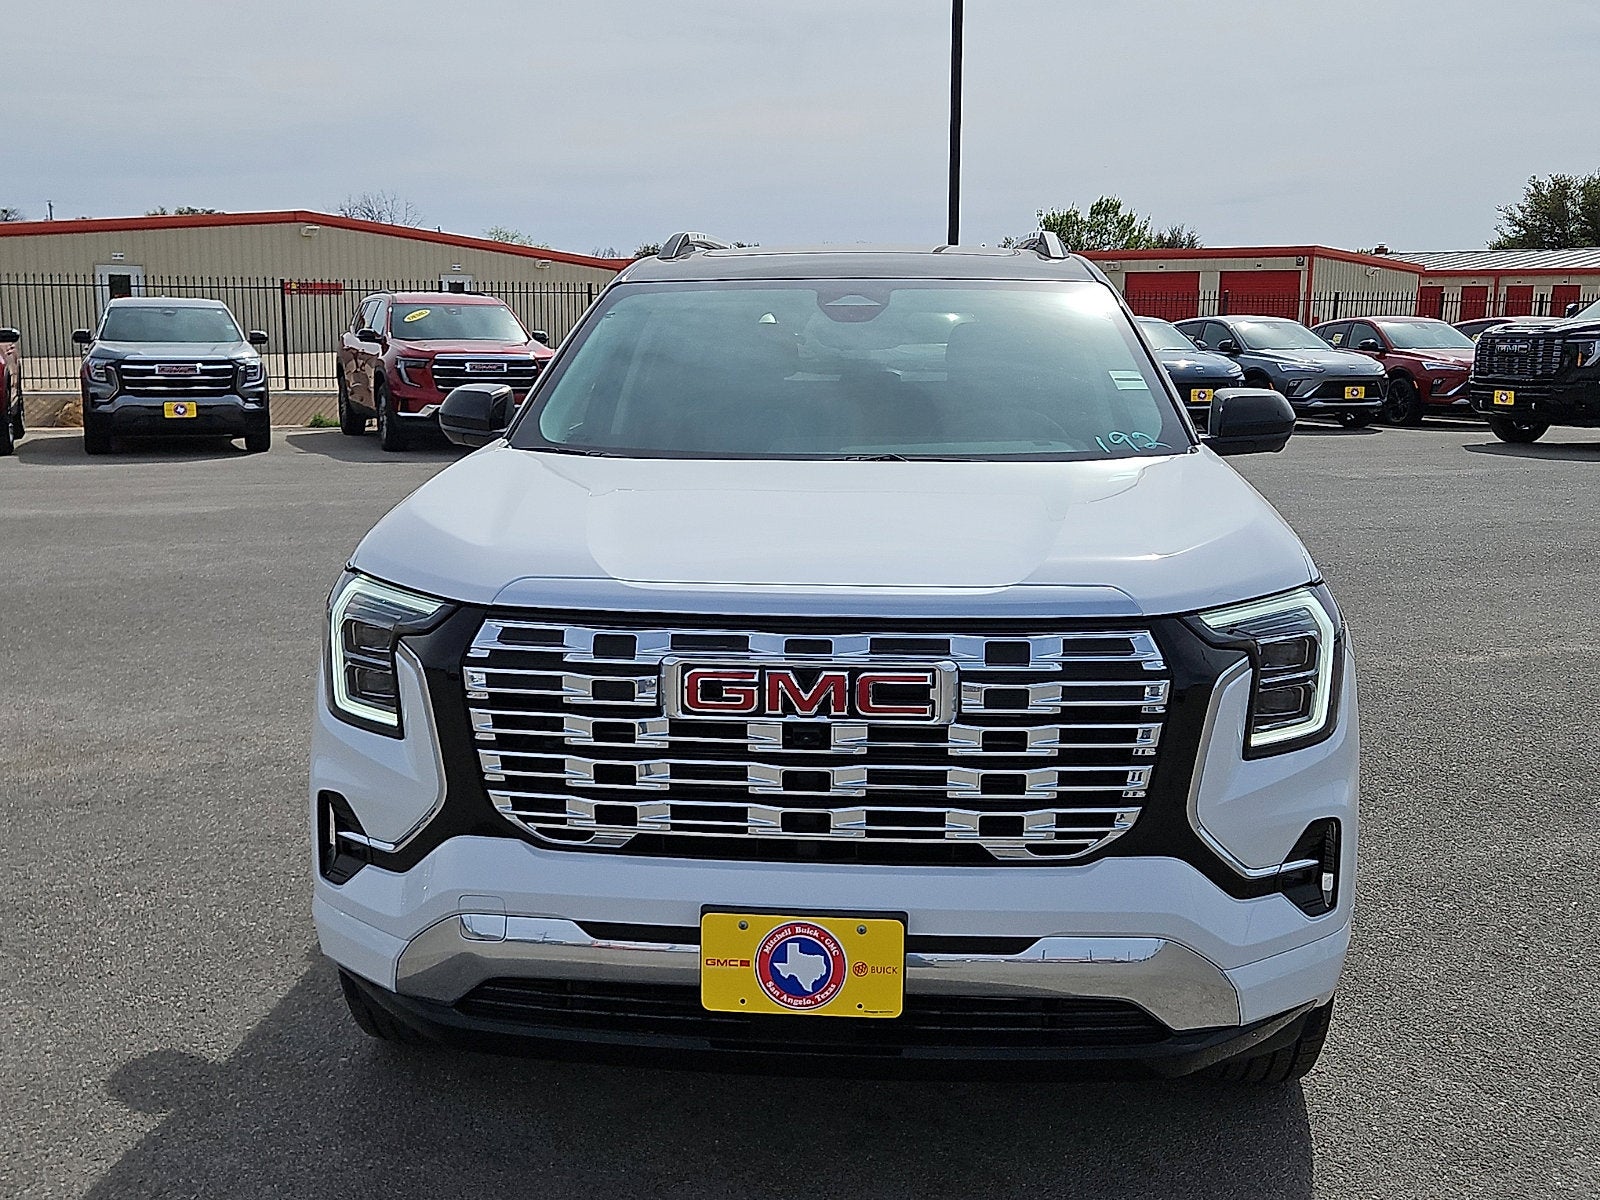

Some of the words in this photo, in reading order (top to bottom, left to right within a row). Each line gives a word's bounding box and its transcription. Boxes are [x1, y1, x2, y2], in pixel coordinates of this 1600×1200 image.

[1094, 431, 1173, 453] 192
[683, 668, 932, 717] GMC
[763, 927, 792, 955] Mitchell
[795, 926, 820, 938] Buick
[824, 937, 840, 957] GMC
[705, 958, 739, 967] GMC
[870, 965, 898, 975] BUICK
[766, 980, 780, 997] San
[815, 983, 837, 1002] Texas
